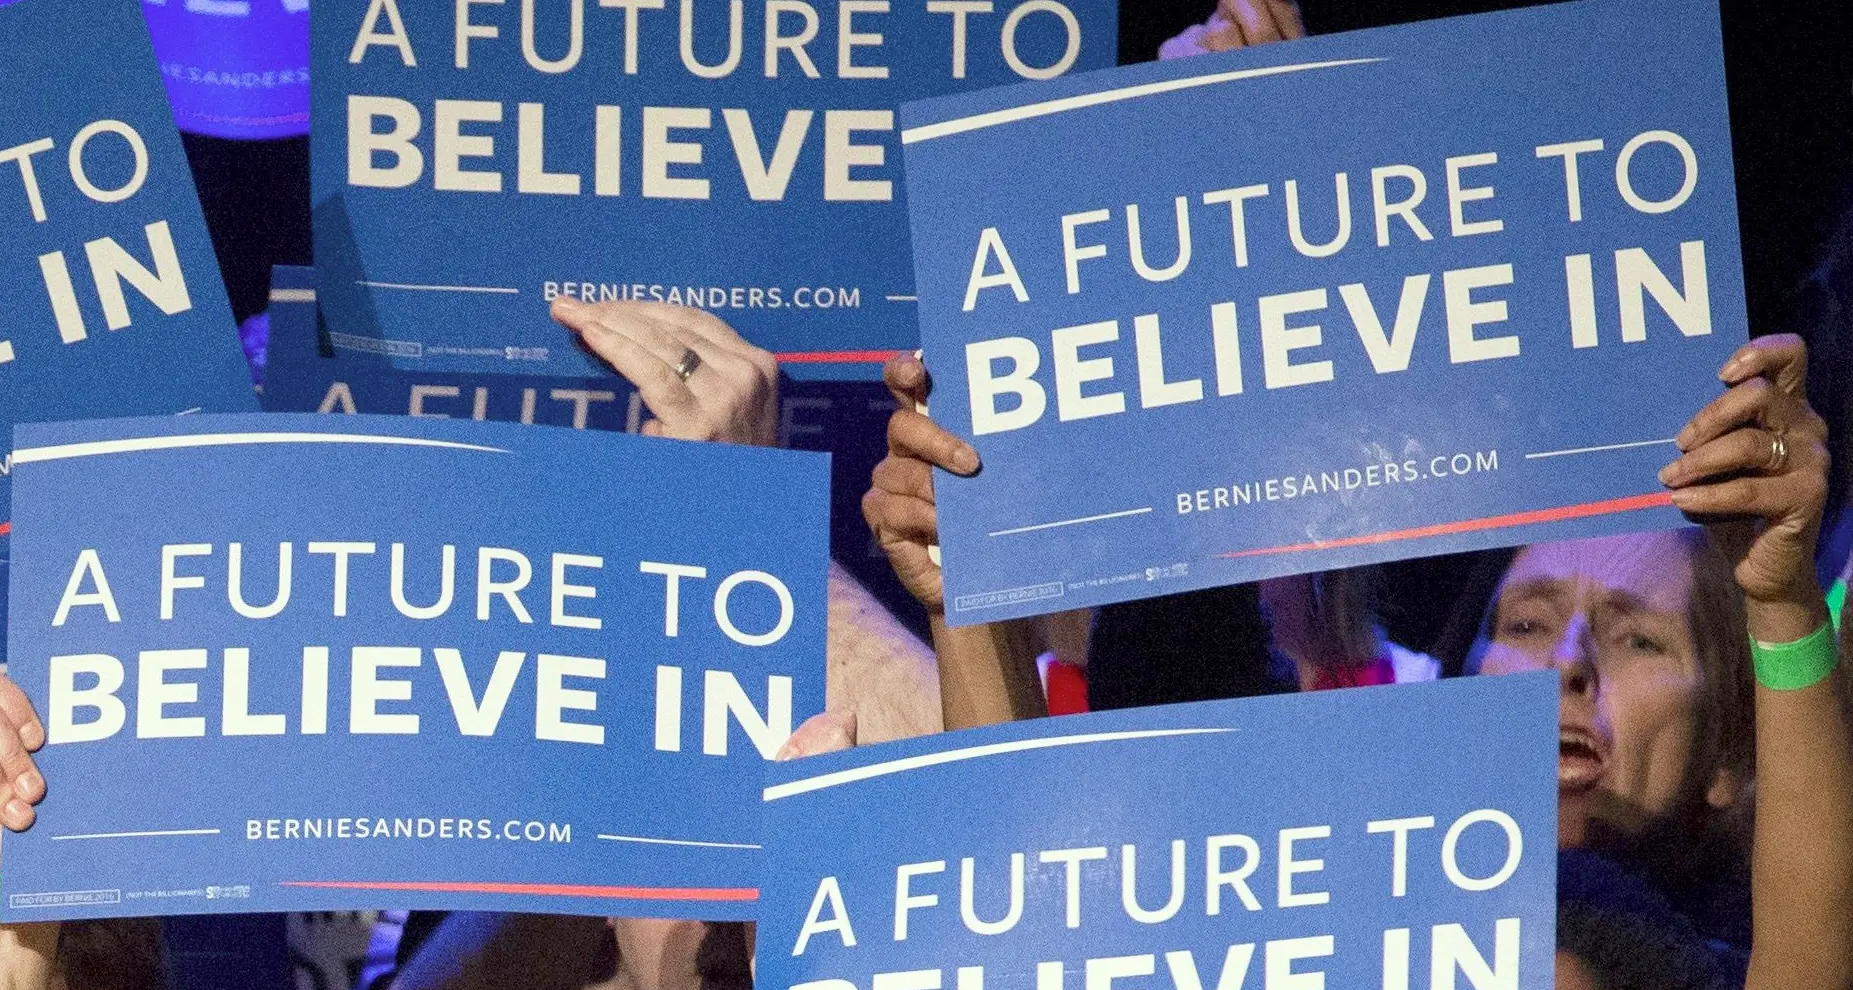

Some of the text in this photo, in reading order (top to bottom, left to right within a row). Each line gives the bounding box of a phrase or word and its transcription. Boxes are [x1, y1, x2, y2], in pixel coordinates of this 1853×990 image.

[350, 0, 1080, 79] A FUTURE TO
[348, 96, 893, 200] BELIEVE
[963, 131, 1697, 311] A FUTURE TO
[39, 221, 191, 343] IN
[544, 281, 861, 308] BERNIESANDERS.COM
[966, 264, 1519, 435] BELIEVE
[1566, 241, 1711, 348] IN
[1176, 450, 1499, 516] BERNIESANDERS.COM
[52, 542, 793, 646] A FUTURE TO
[48, 647, 605, 745] BELIEVE
[655, 665, 793, 761] IN
[246, 817, 571, 843] BERNIESANDERS.COM
[793, 809, 1522, 955] A FUTURE TO
